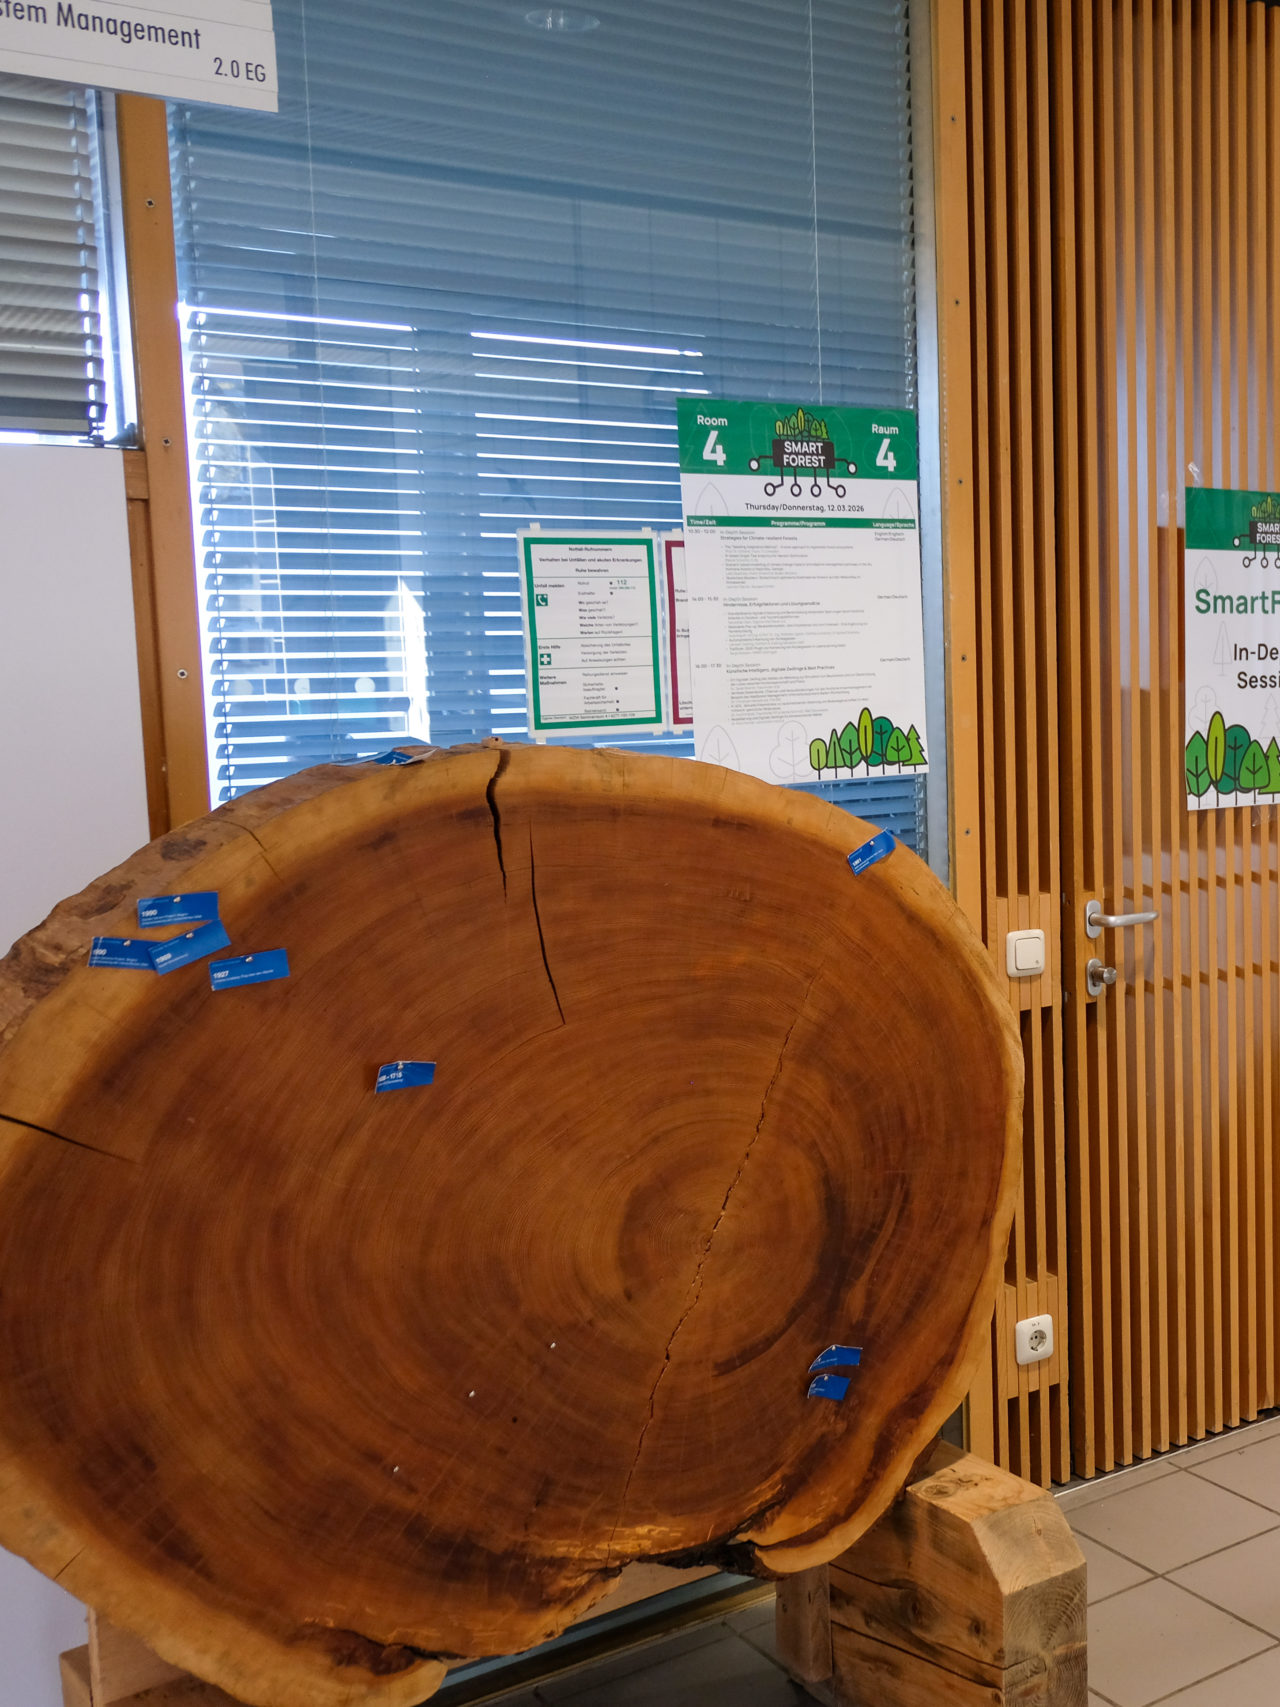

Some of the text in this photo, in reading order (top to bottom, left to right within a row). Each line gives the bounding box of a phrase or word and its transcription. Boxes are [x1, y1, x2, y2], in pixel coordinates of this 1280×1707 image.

[56, 2, 200, 49] Management
[213, 57, 266, 82] 2.0 EG
[697, 415, 728, 427] Room
[872, 424, 900, 435] Raum
[702, 430, 726, 466] 4
[784, 442, 824, 454] SMART
[876, 438, 896, 472] 4
[783, 454, 826, 468] FOREST
